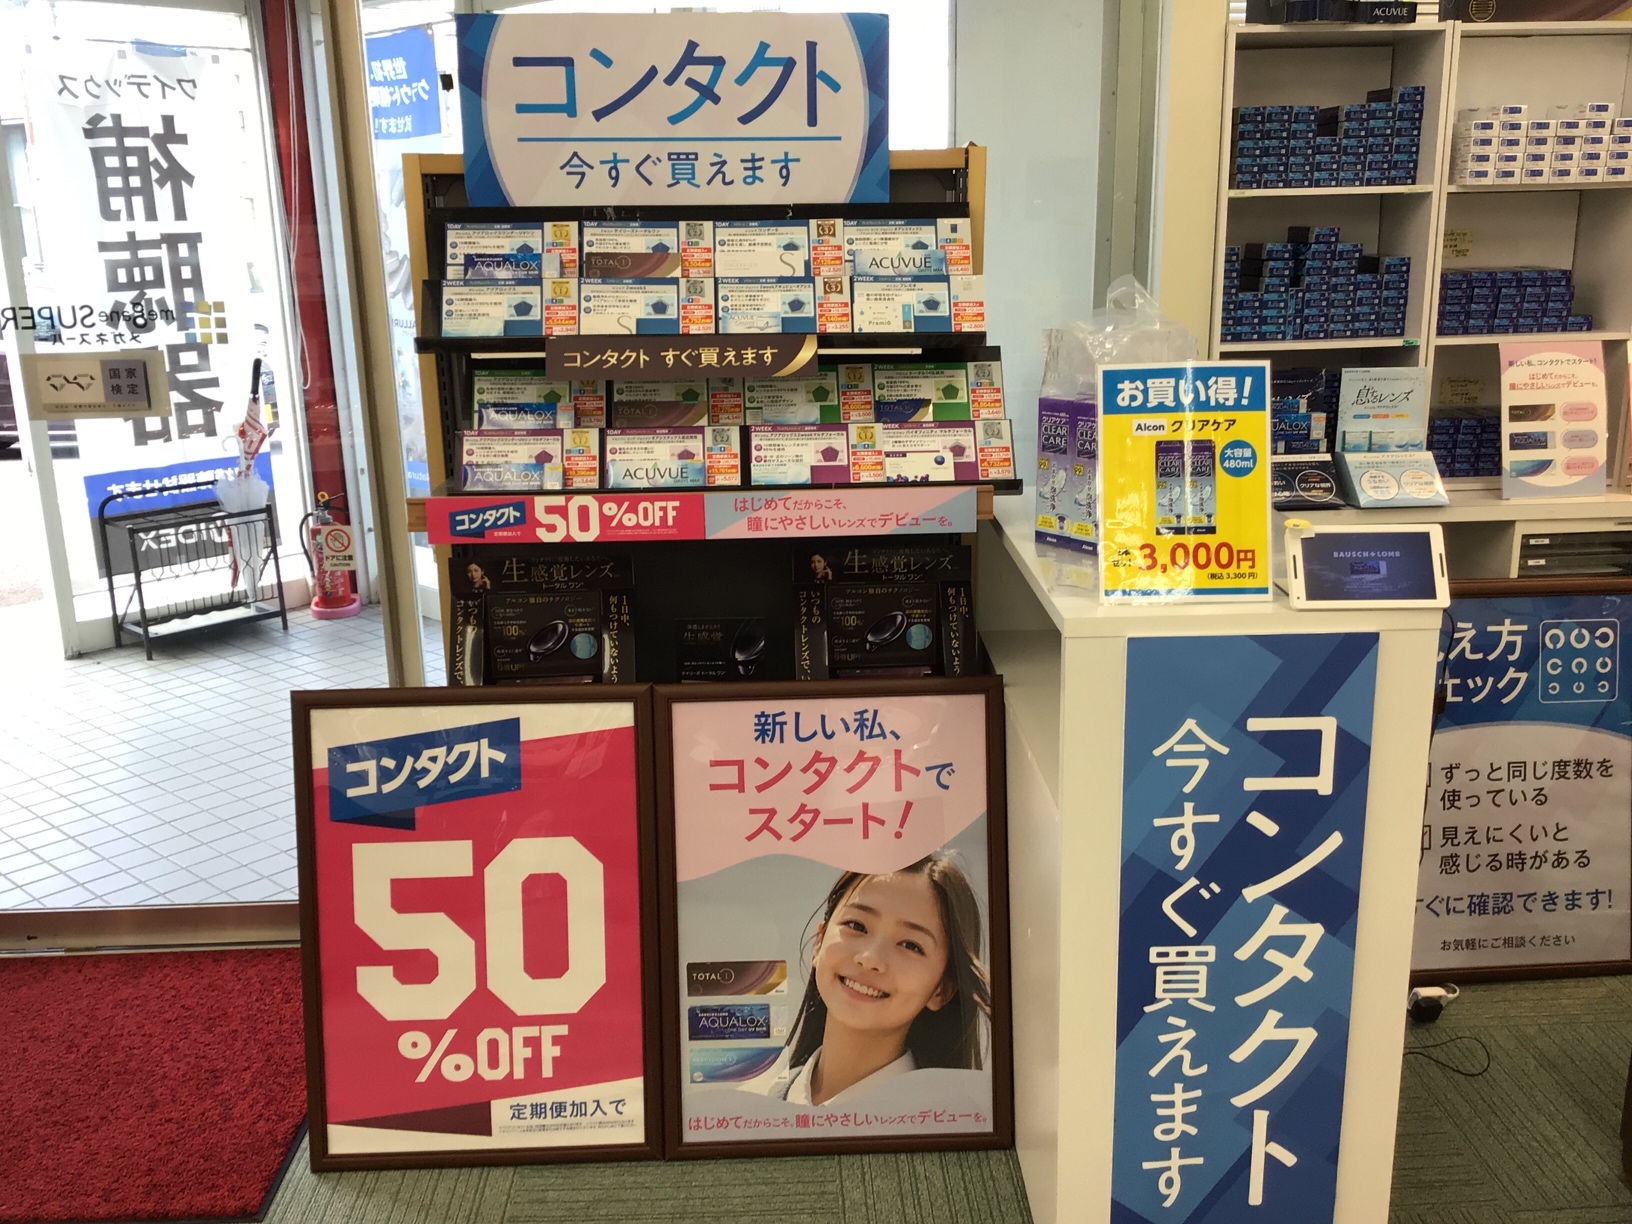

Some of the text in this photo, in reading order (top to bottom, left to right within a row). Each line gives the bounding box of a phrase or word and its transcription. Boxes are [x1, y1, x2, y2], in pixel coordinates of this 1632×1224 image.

[1373, 7, 1408, 17] ACUVUE
[512, 39, 842, 128] コンタクト
[559, 150, 801, 190] 今すぐ買えます
[475, 261, 538, 271] AQUALOX
[869, 257, 932, 268] ACUVUE
[563, 345, 778, 369] コンタクト すぐ買えます
[108, 367, 137, 379] 国家
[110, 383, 139, 395] 検定
[1116, 376, 1252, 408] お買い得!
[489, 411, 553, 420] AQUALOX
[1135, 419, 1236, 432] Alcon クリアケア
[1042, 425, 1067, 435] CLEAR
[1042, 435, 1067, 448] CARE
[1223, 459, 1253, 468] 480ml
[1224, 448, 1252, 458] 大容量
[474, 472, 540, 481] AQUALOX
[623, 467, 689, 480] ACUVUE
[734, 496, 847, 512] はじめてだからこそ、
[455, 505, 521, 531] コンタクト
[747, 513, 953, 532] 瞳にやさしいレンズでデビューを。
[325, 554, 353, 562] ドアに注意
[843, 549, 954, 574] 生感覚レンズ
[1138, 542, 1256, 573] 3,000円
[502, 557, 614, 583] 生感覚レンズ
[810, 590, 821, 623] いつもの
[1437, 619, 1529, 662] え方
[1439, 666, 1529, 704] ェック
[753, 708, 902, 744] 新しい私、
[346, 738, 508, 798] コンタクト
[709, 749, 956, 795] コンタクトで
[1440, 757, 1615, 783] ずっと同じ度数を
[1439, 787, 1549, 810] 使っている
[745, 801, 914, 842] スタート!
[1440, 822, 1570, 848] 見えにくいと
[1438, 849, 1592, 875] 感じる時がある
[351, 836, 607, 1021] 50
[1440, 934, 1576, 951] お気軽にご相談ください
[1141, 717, 1230, 1208] 今すぐ買えます
[1229, 716, 1343, 1206] コンタクト
[699, 1016, 766, 1028] AQUALOX
[398, 1024, 569, 1083] %OFF
[509, 1099, 626, 1121] 定期便加入で
